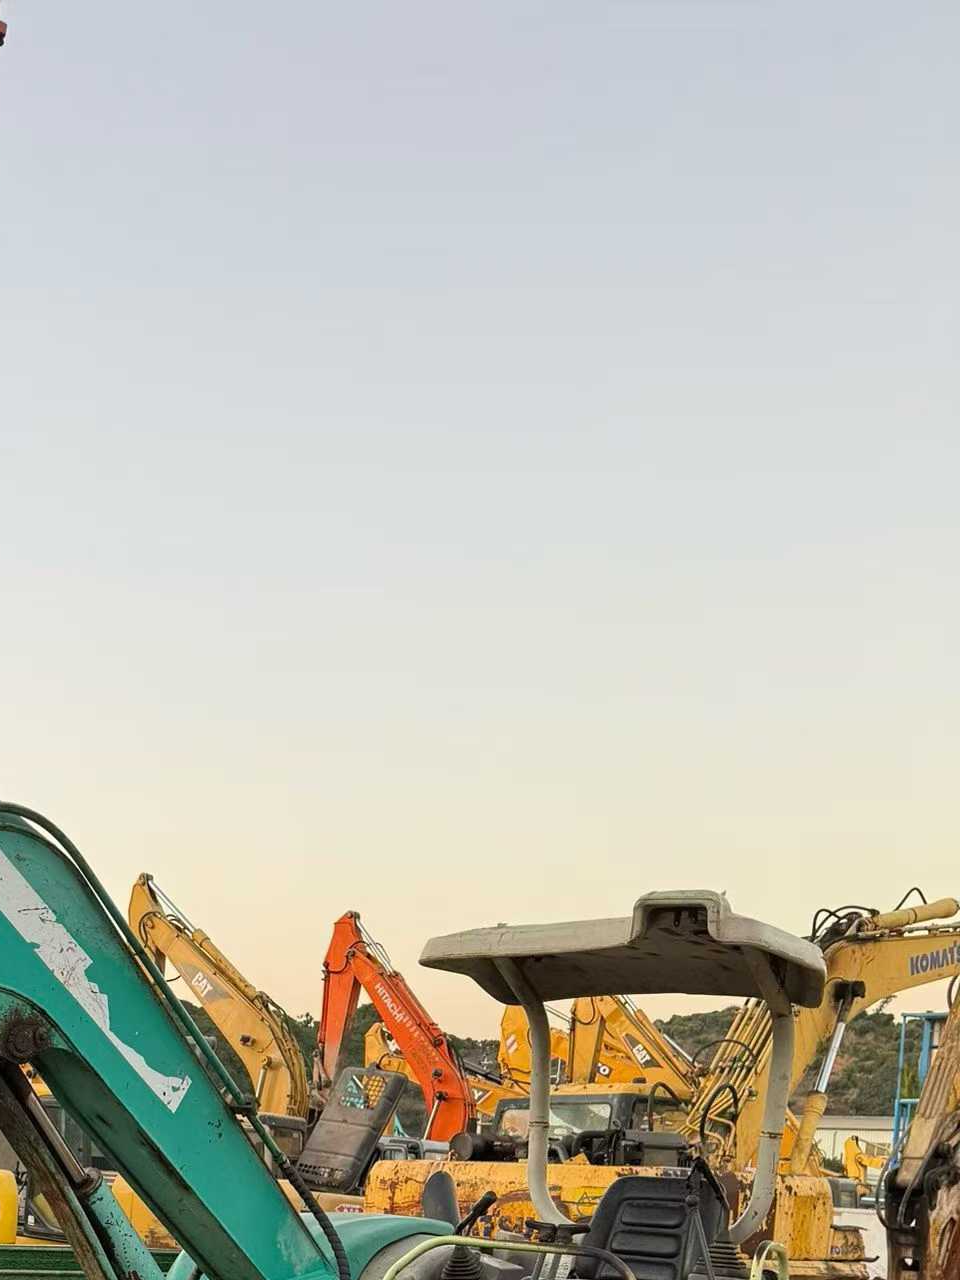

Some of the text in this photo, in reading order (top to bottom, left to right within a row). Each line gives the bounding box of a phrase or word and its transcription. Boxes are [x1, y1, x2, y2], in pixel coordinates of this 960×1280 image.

[191, 970, 214, 998] CAT
[374, 982, 404, 1024] HITACHI
[632, 1043, 652, 1067] CAT
